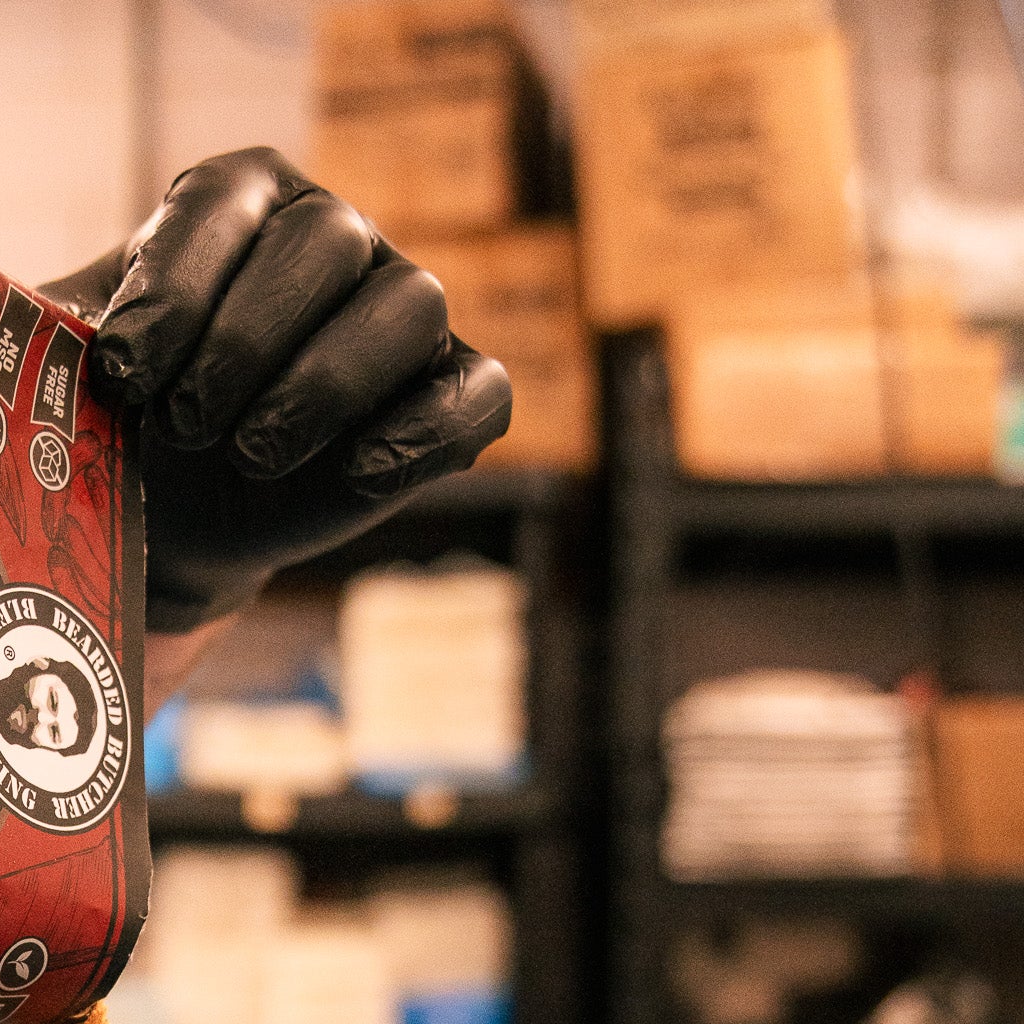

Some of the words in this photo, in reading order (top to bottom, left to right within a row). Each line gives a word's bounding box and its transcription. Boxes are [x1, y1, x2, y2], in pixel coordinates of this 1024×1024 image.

[3, 342, 19, 373] NO
[43, 365, 58, 406] FREE
[53, 365, 69, 418] SUGAR
[51, 607, 123, 726] BEARDED
[51, 735, 123, 820] BUTCHER
